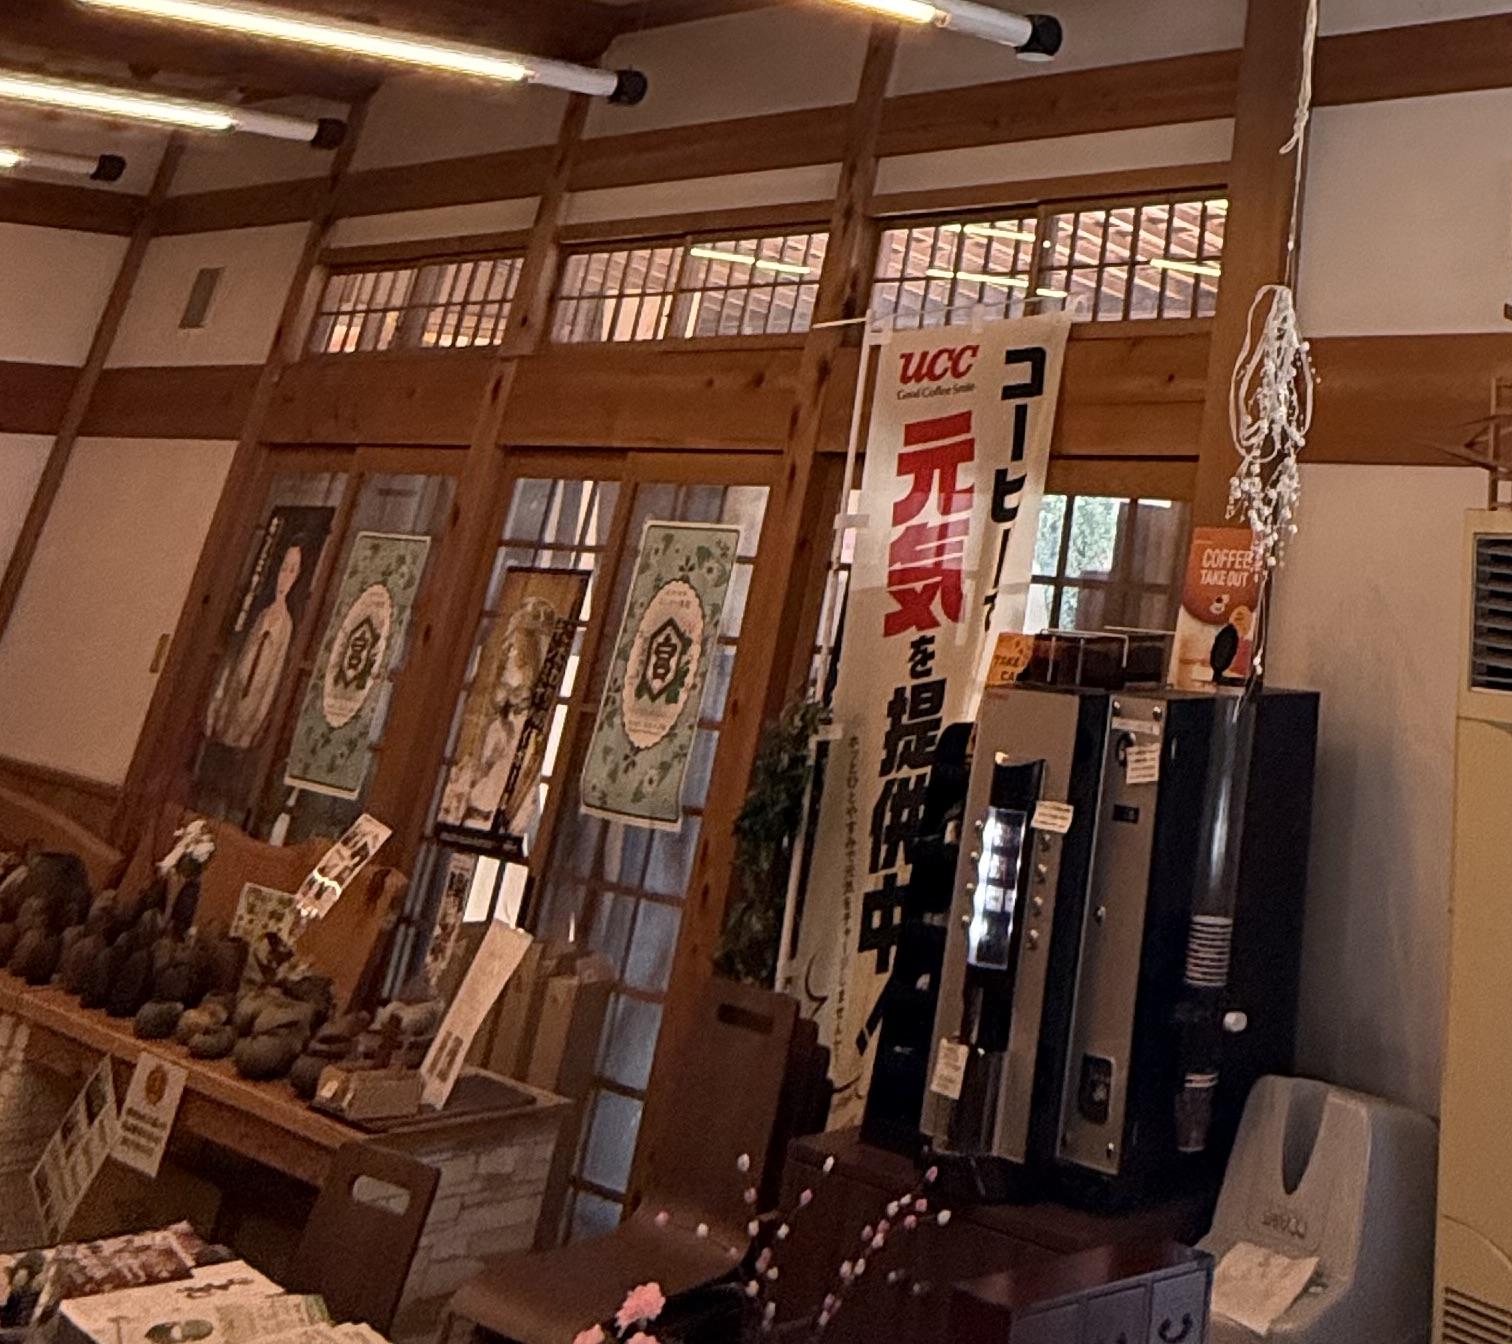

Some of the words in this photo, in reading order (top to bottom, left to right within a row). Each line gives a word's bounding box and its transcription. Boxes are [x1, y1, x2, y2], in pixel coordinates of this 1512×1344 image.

[1201, 548, 1254, 570] COFFEE
[1200, 569, 1226, 586] TAKE
[1226, 571, 1250, 588] OUT
